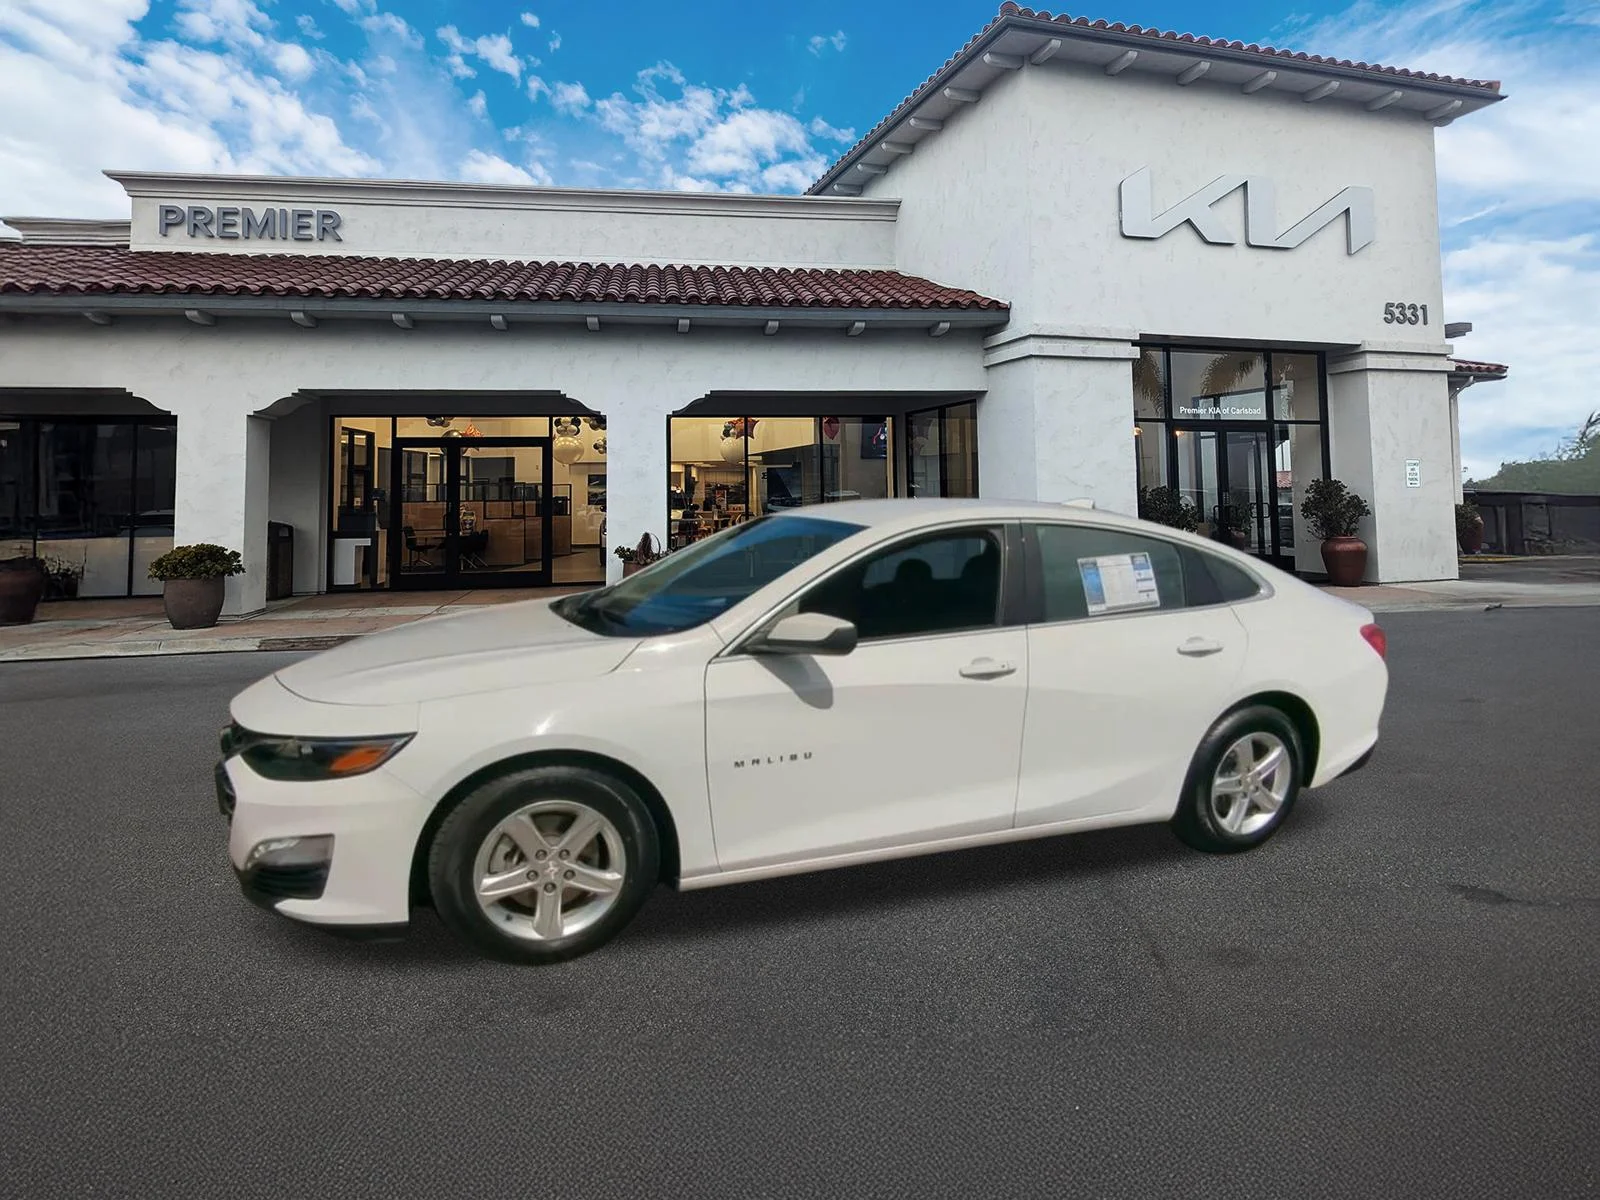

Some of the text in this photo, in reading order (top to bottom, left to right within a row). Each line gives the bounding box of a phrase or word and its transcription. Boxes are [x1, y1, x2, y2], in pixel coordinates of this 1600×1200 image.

[1118, 165, 1375, 256] KIA
[159, 205, 342, 241] PREMIER
[1384, 302, 1428, 325] 5331
[1180, 406, 1207, 414] Premier
[1231, 407, 1261, 415] Carlsbad
[734, 752, 812, 768] MALIBU
